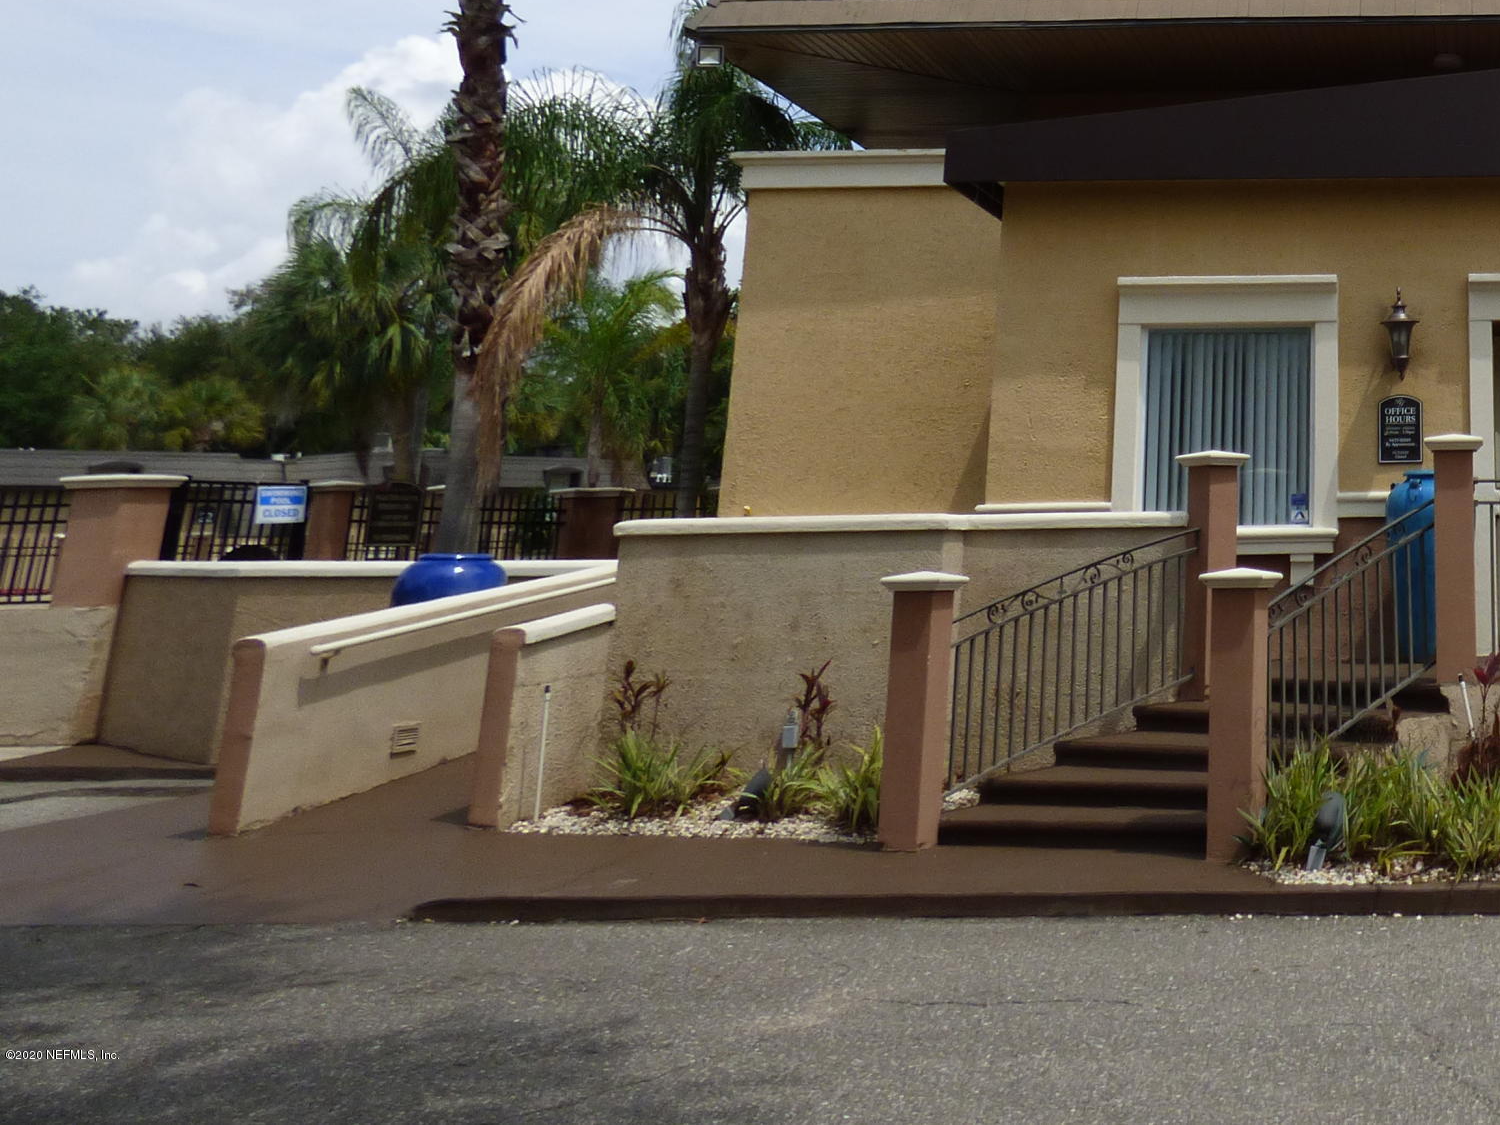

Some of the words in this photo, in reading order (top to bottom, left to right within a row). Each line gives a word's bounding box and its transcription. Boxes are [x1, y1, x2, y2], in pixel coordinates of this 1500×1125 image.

[1384, 407, 1416, 415] OFFICE
[1385, 415, 1416, 423] HOURS
[262, 508, 300, 518] CLOSED
